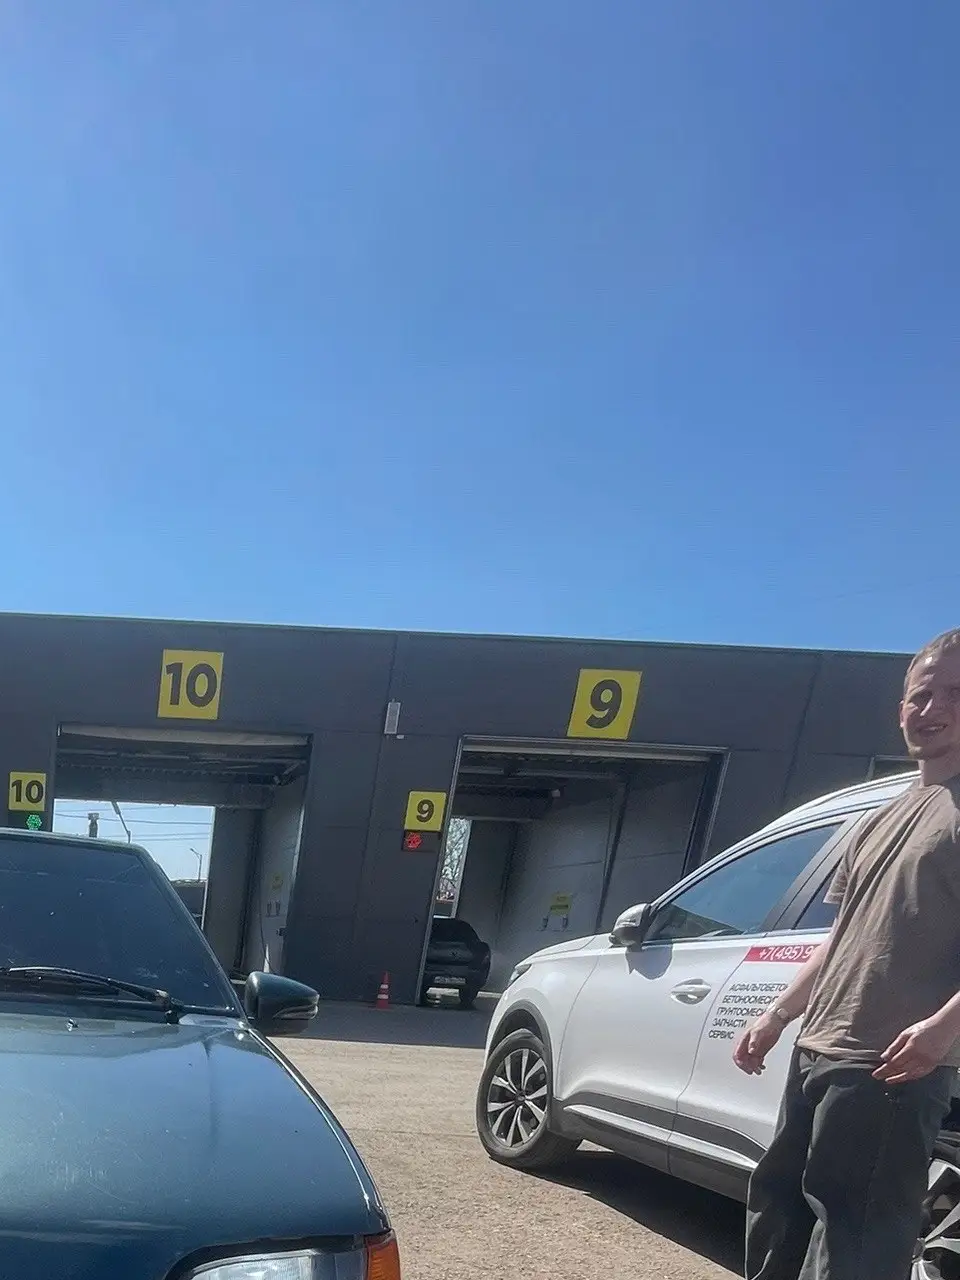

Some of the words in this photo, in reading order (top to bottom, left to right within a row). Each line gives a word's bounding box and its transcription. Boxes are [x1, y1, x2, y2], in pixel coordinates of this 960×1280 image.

[165, 662, 218, 708] 10
[584, 679, 623, 728] 9
[10, 779, 44, 805] 10
[415, 798, 434, 822] 9
[708, 1029, 735, 1039] СЕРВИС
[712, 1017, 748, 1028] ЗАПЧАСТИ
